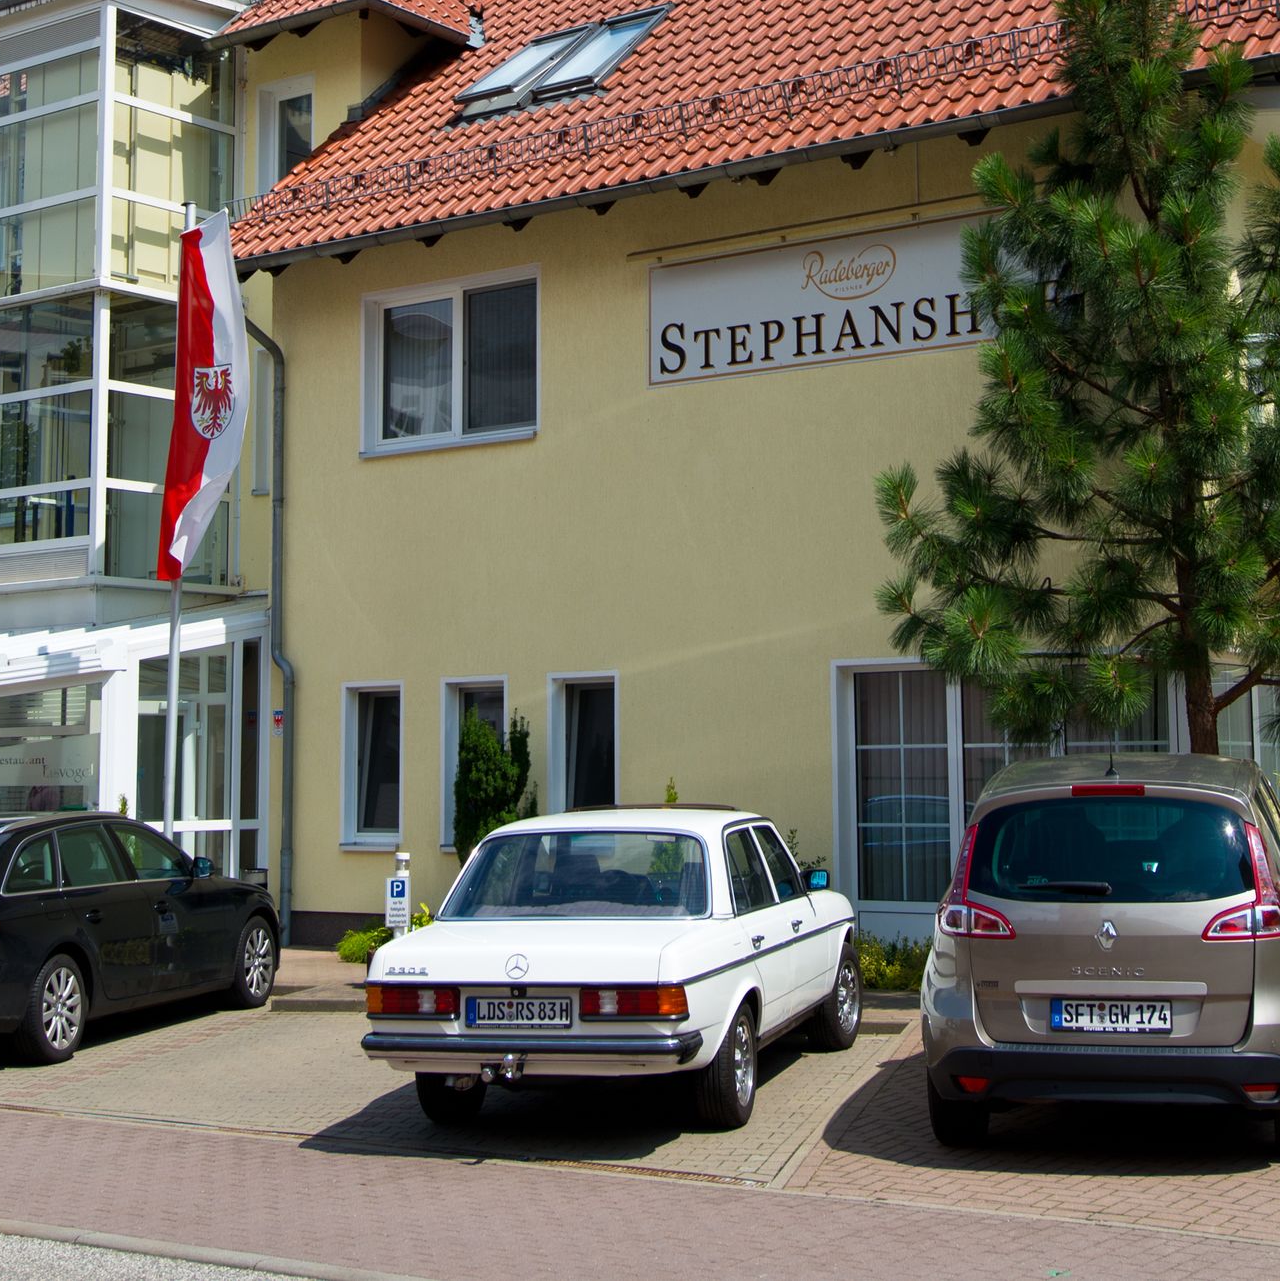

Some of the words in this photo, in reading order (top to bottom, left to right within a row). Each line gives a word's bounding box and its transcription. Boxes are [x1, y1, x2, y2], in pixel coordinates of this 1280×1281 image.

[800, 245, 895, 290] Radeberger
[658, 291, 1000, 375] STEPHANSH
[393, 881, 402, 897] P
[1071, 966, 1146, 976] SCENIC
[476, 1002, 506, 1021] LDS
[515, 1002, 534, 1021] RS
[1063, 1003, 1097, 1025] SFT
[1108, 1004, 1131, 1025] GW
[1135, 1004, 1168, 1025] 174
